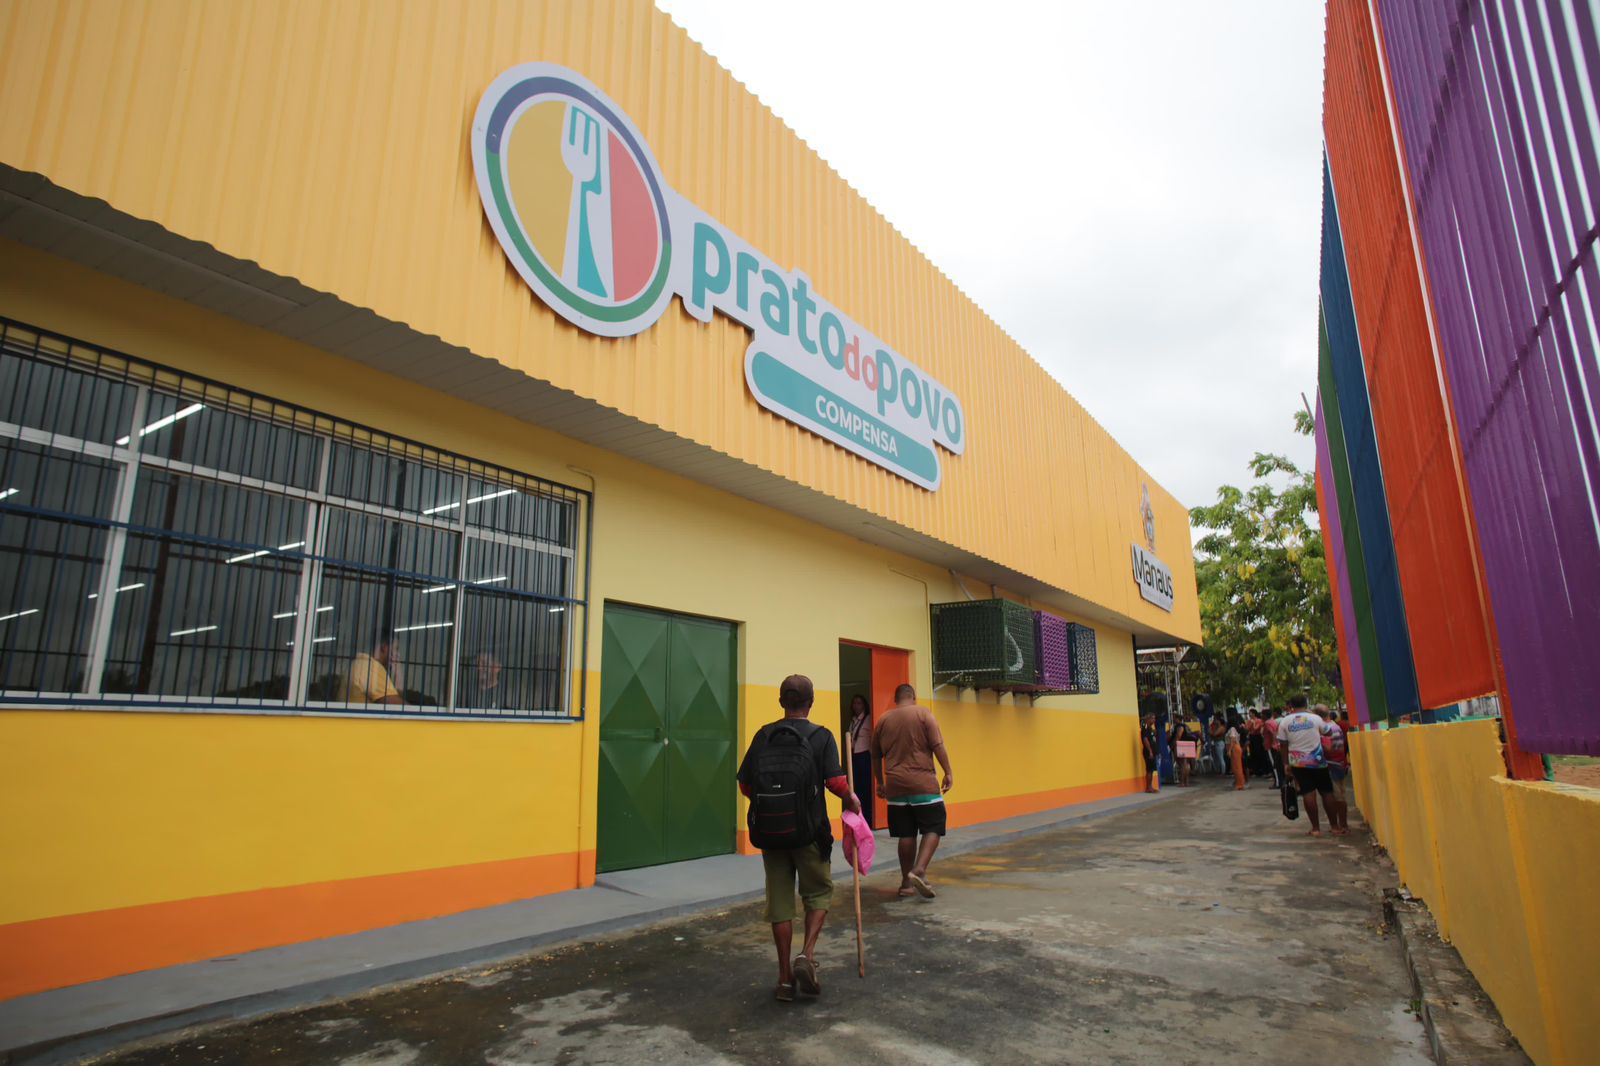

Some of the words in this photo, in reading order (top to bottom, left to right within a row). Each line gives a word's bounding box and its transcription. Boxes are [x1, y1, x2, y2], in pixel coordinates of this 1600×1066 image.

[691, 222, 846, 371] prato
[875, 349, 961, 445] povo
[815, 395, 898, 457] COMPENSA
[1133, 545, 1174, 599] Manaus
